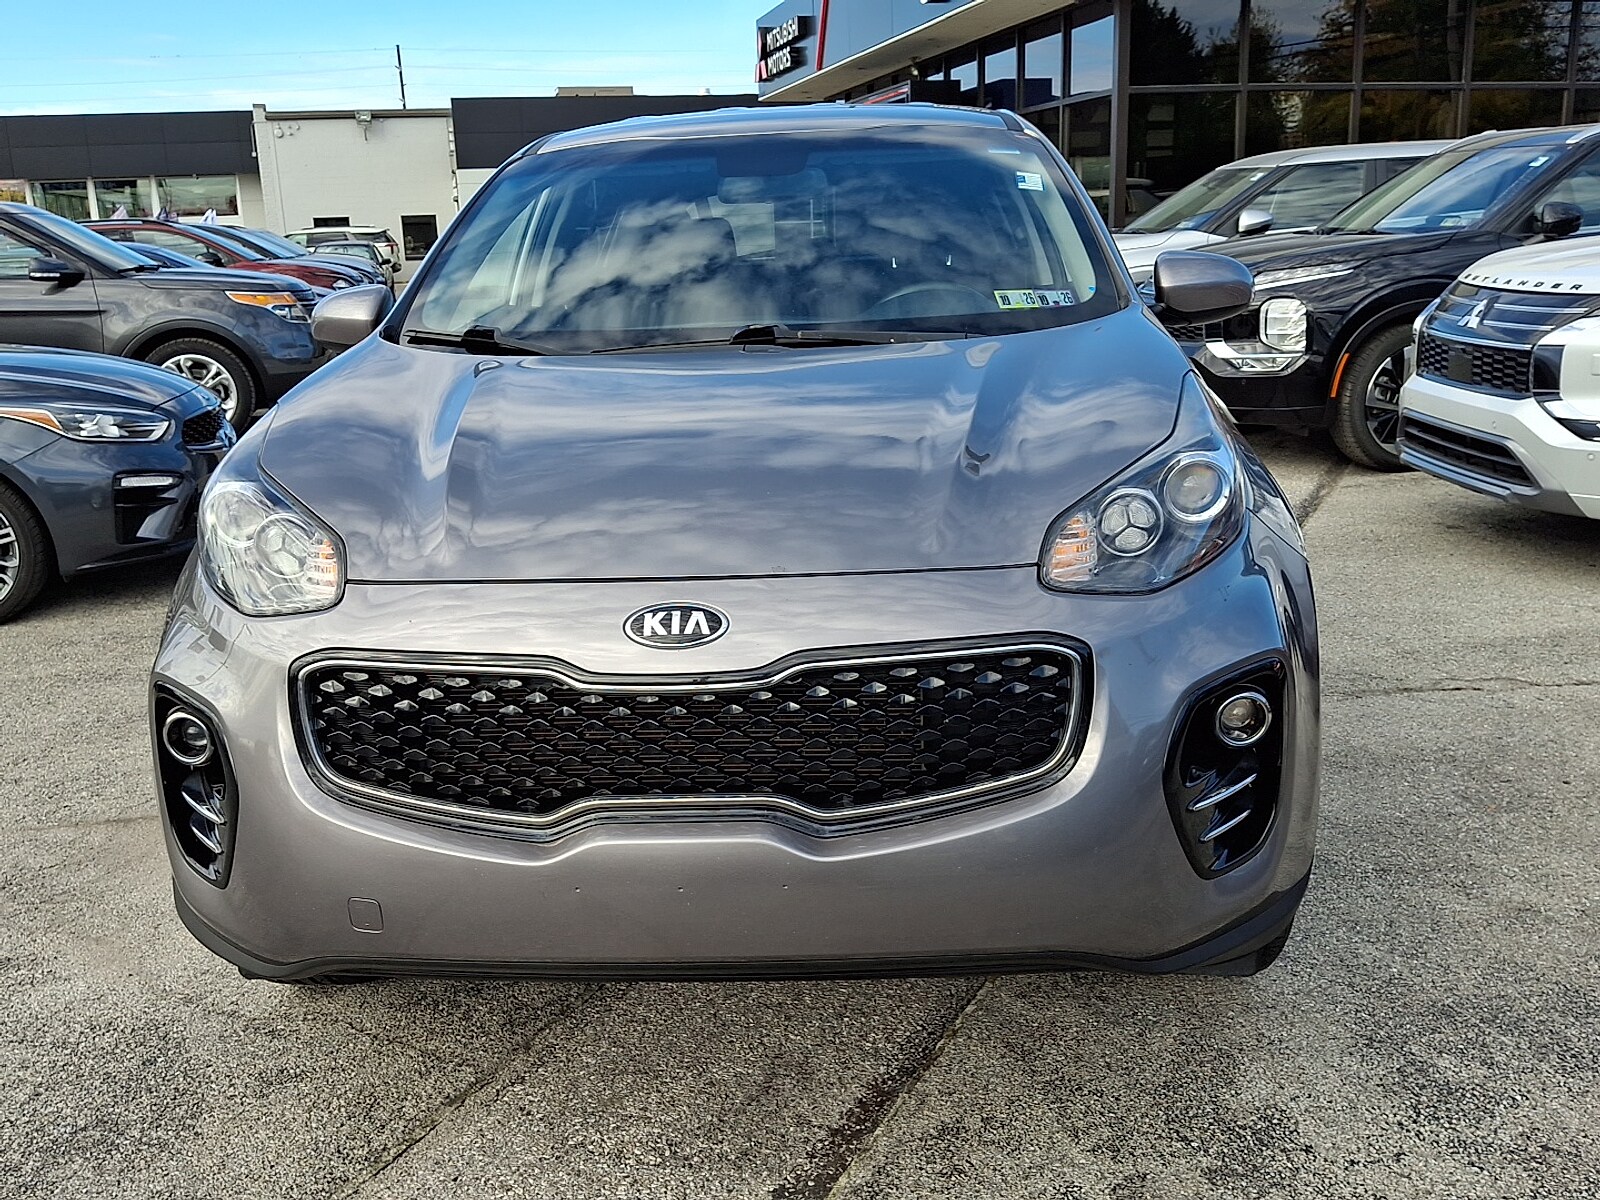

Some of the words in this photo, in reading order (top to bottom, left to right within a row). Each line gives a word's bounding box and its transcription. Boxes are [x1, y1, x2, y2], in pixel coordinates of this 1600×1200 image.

[767, 46, 791, 76] MOTORS
[1023, 292, 1035, 304] 26
[1060, 292, 1074, 304] 26
[643, 610, 711, 636] KIA
